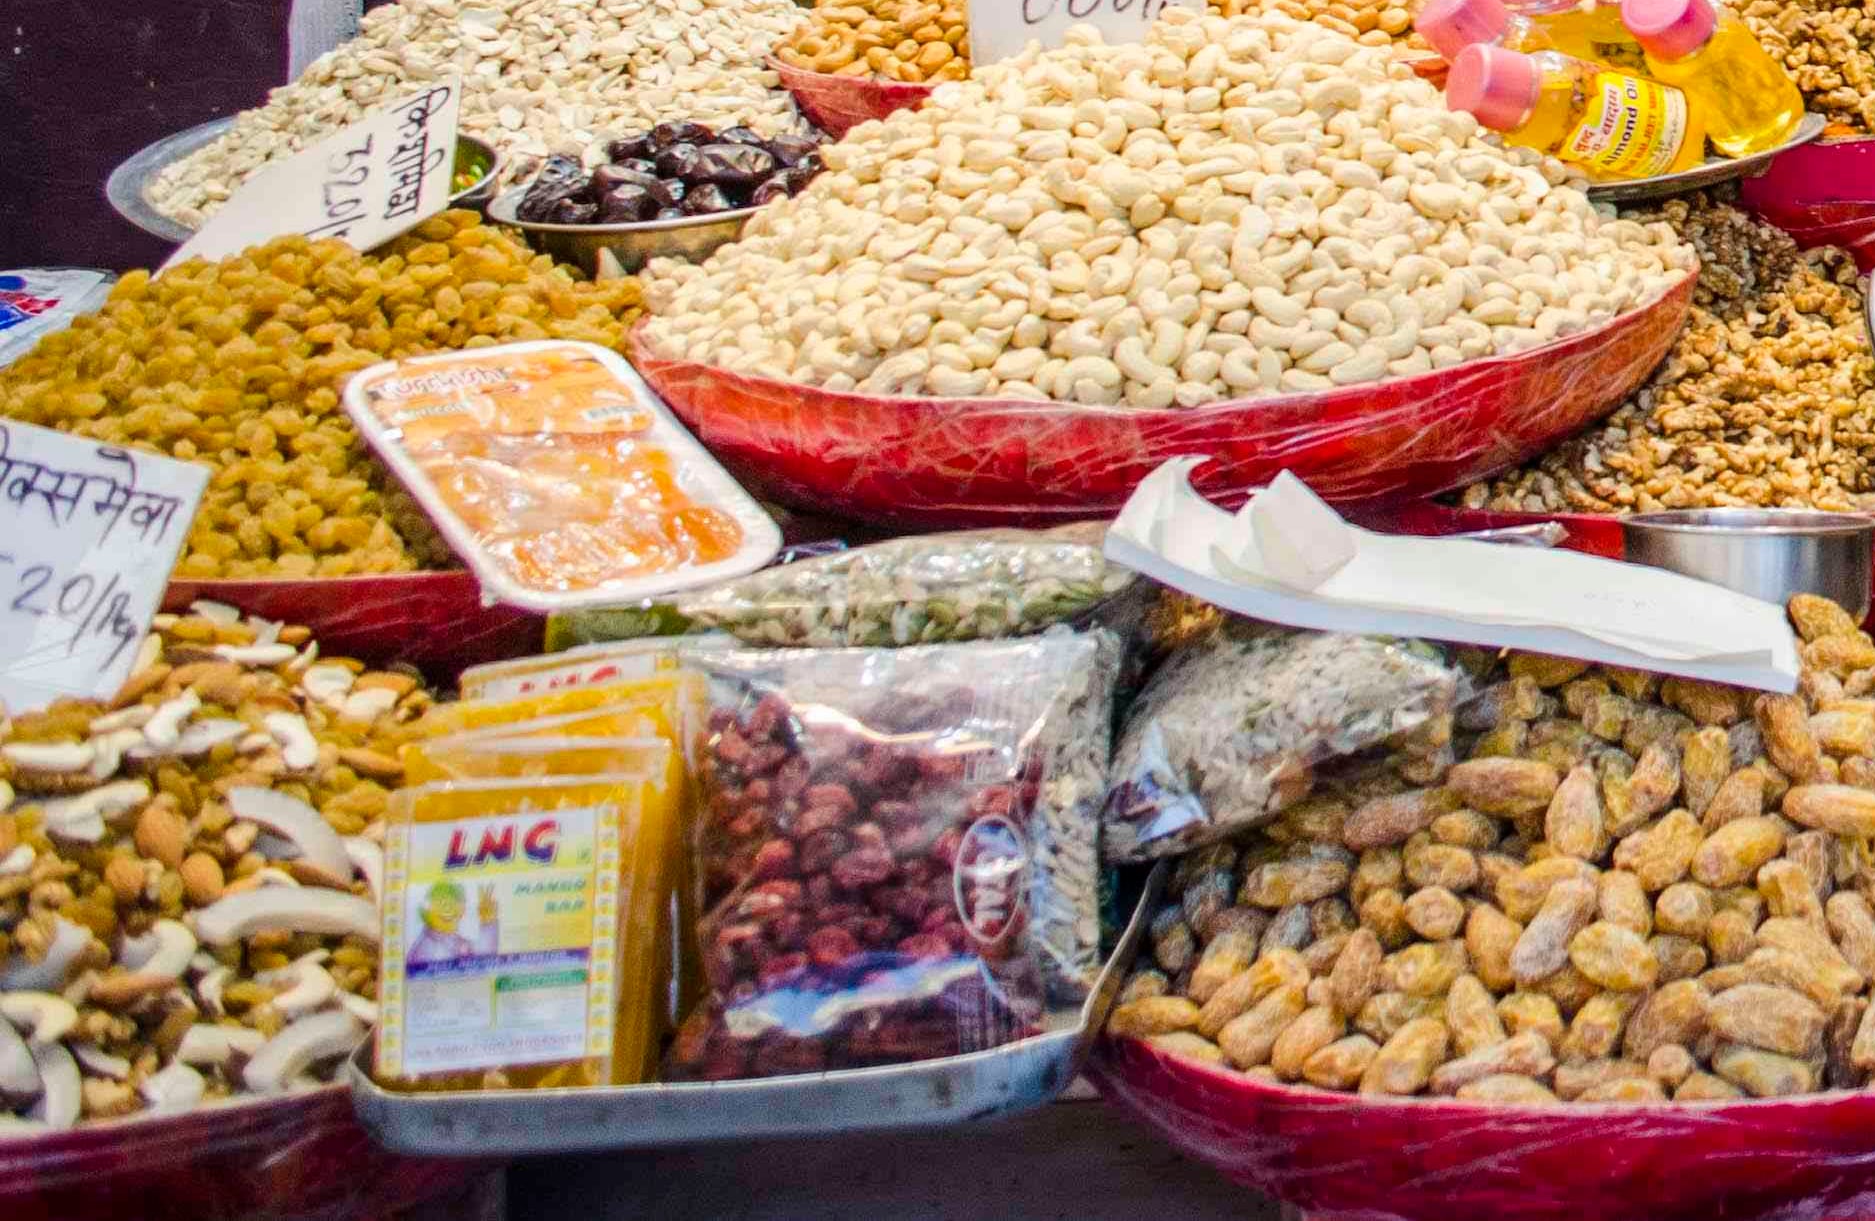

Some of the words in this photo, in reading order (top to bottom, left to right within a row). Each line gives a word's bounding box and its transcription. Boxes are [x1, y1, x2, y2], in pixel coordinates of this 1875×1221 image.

[1602, 106, 1638, 167] Almond
[1624, 77, 1639, 100] Oil
[443, 820, 562, 871] LNG
